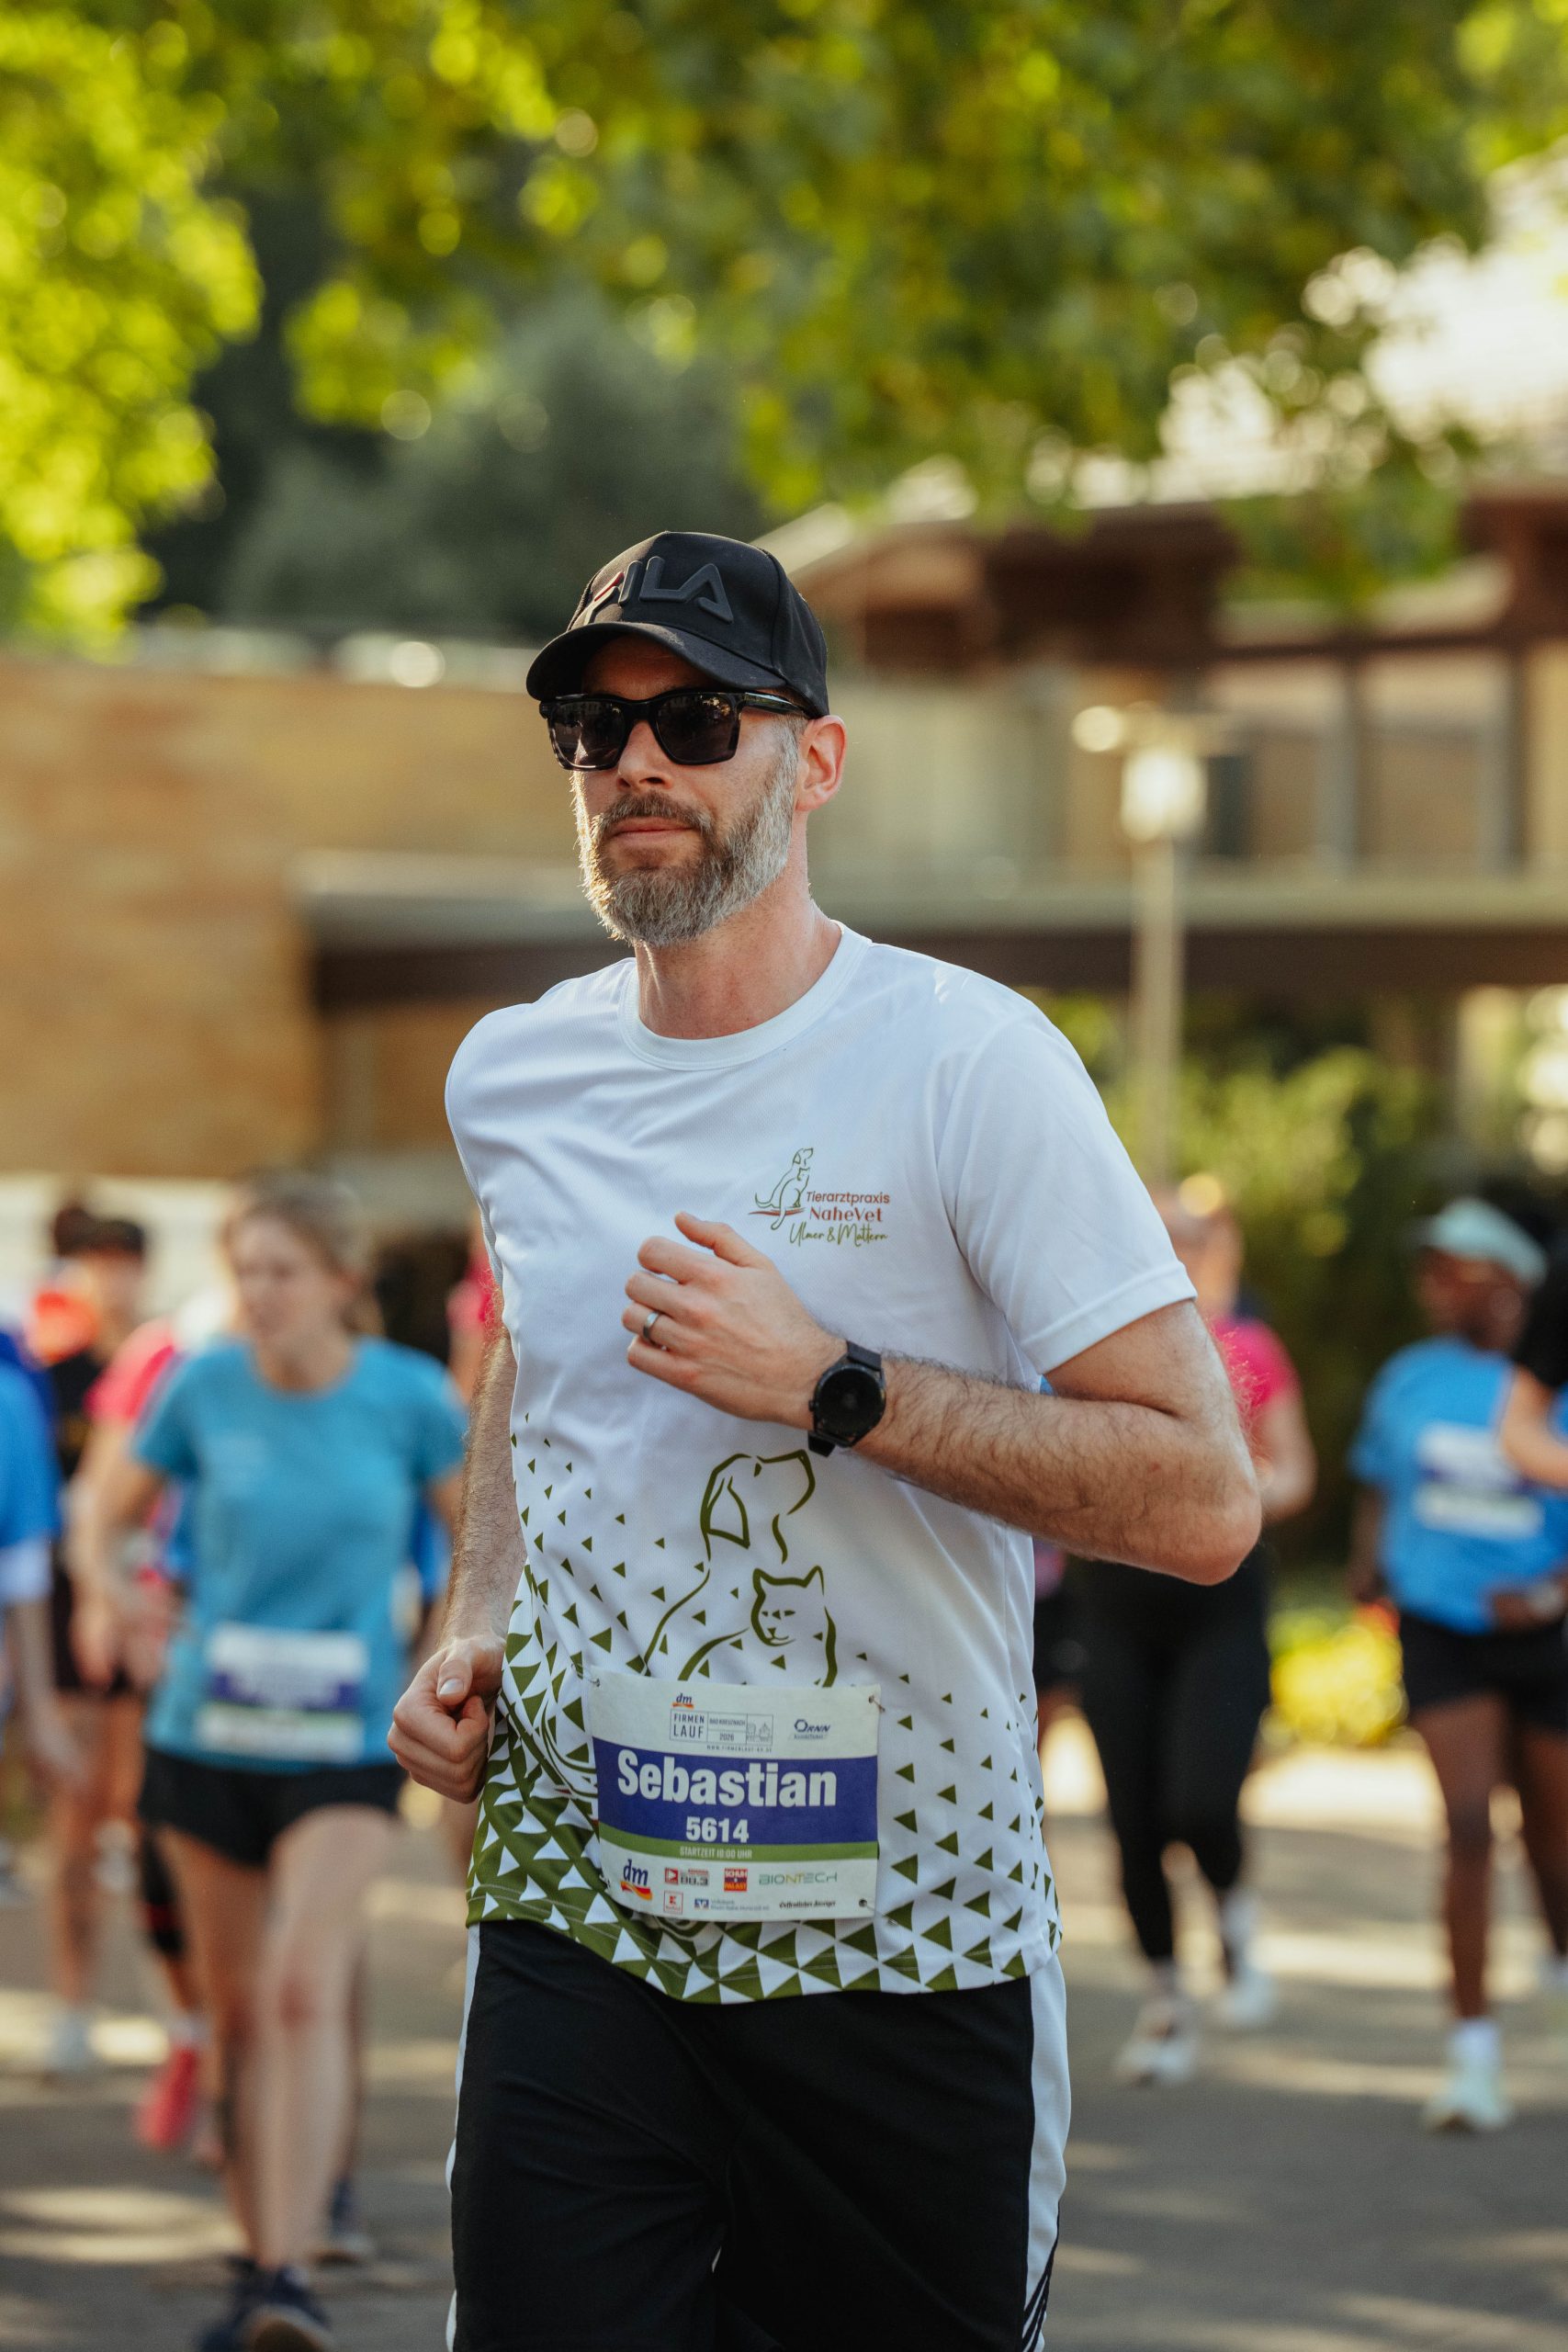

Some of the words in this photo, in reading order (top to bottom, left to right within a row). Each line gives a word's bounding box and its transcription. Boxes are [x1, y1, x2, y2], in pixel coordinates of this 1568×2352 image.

[807, 1191, 890, 1206] Tierarztpraxis
[809, 1206, 883, 1222] NaheVet
[790, 1221, 824, 1247] Ulmer
[827, 1227, 836, 1242] &
[838, 1221, 888, 1247] Mattern
[676, 1692, 693, 1704] dm
[673, 1713, 705, 1724] FIRMEN
[673, 1724, 704, 1739] LAUF
[617, 1748, 837, 1808] Sebastian
[685, 1815, 750, 1844] 5614
[680, 1846, 716, 1858] STARTZEIT
[737, 1849, 752, 1860] UHR
[623, 1858, 649, 1886] dm
